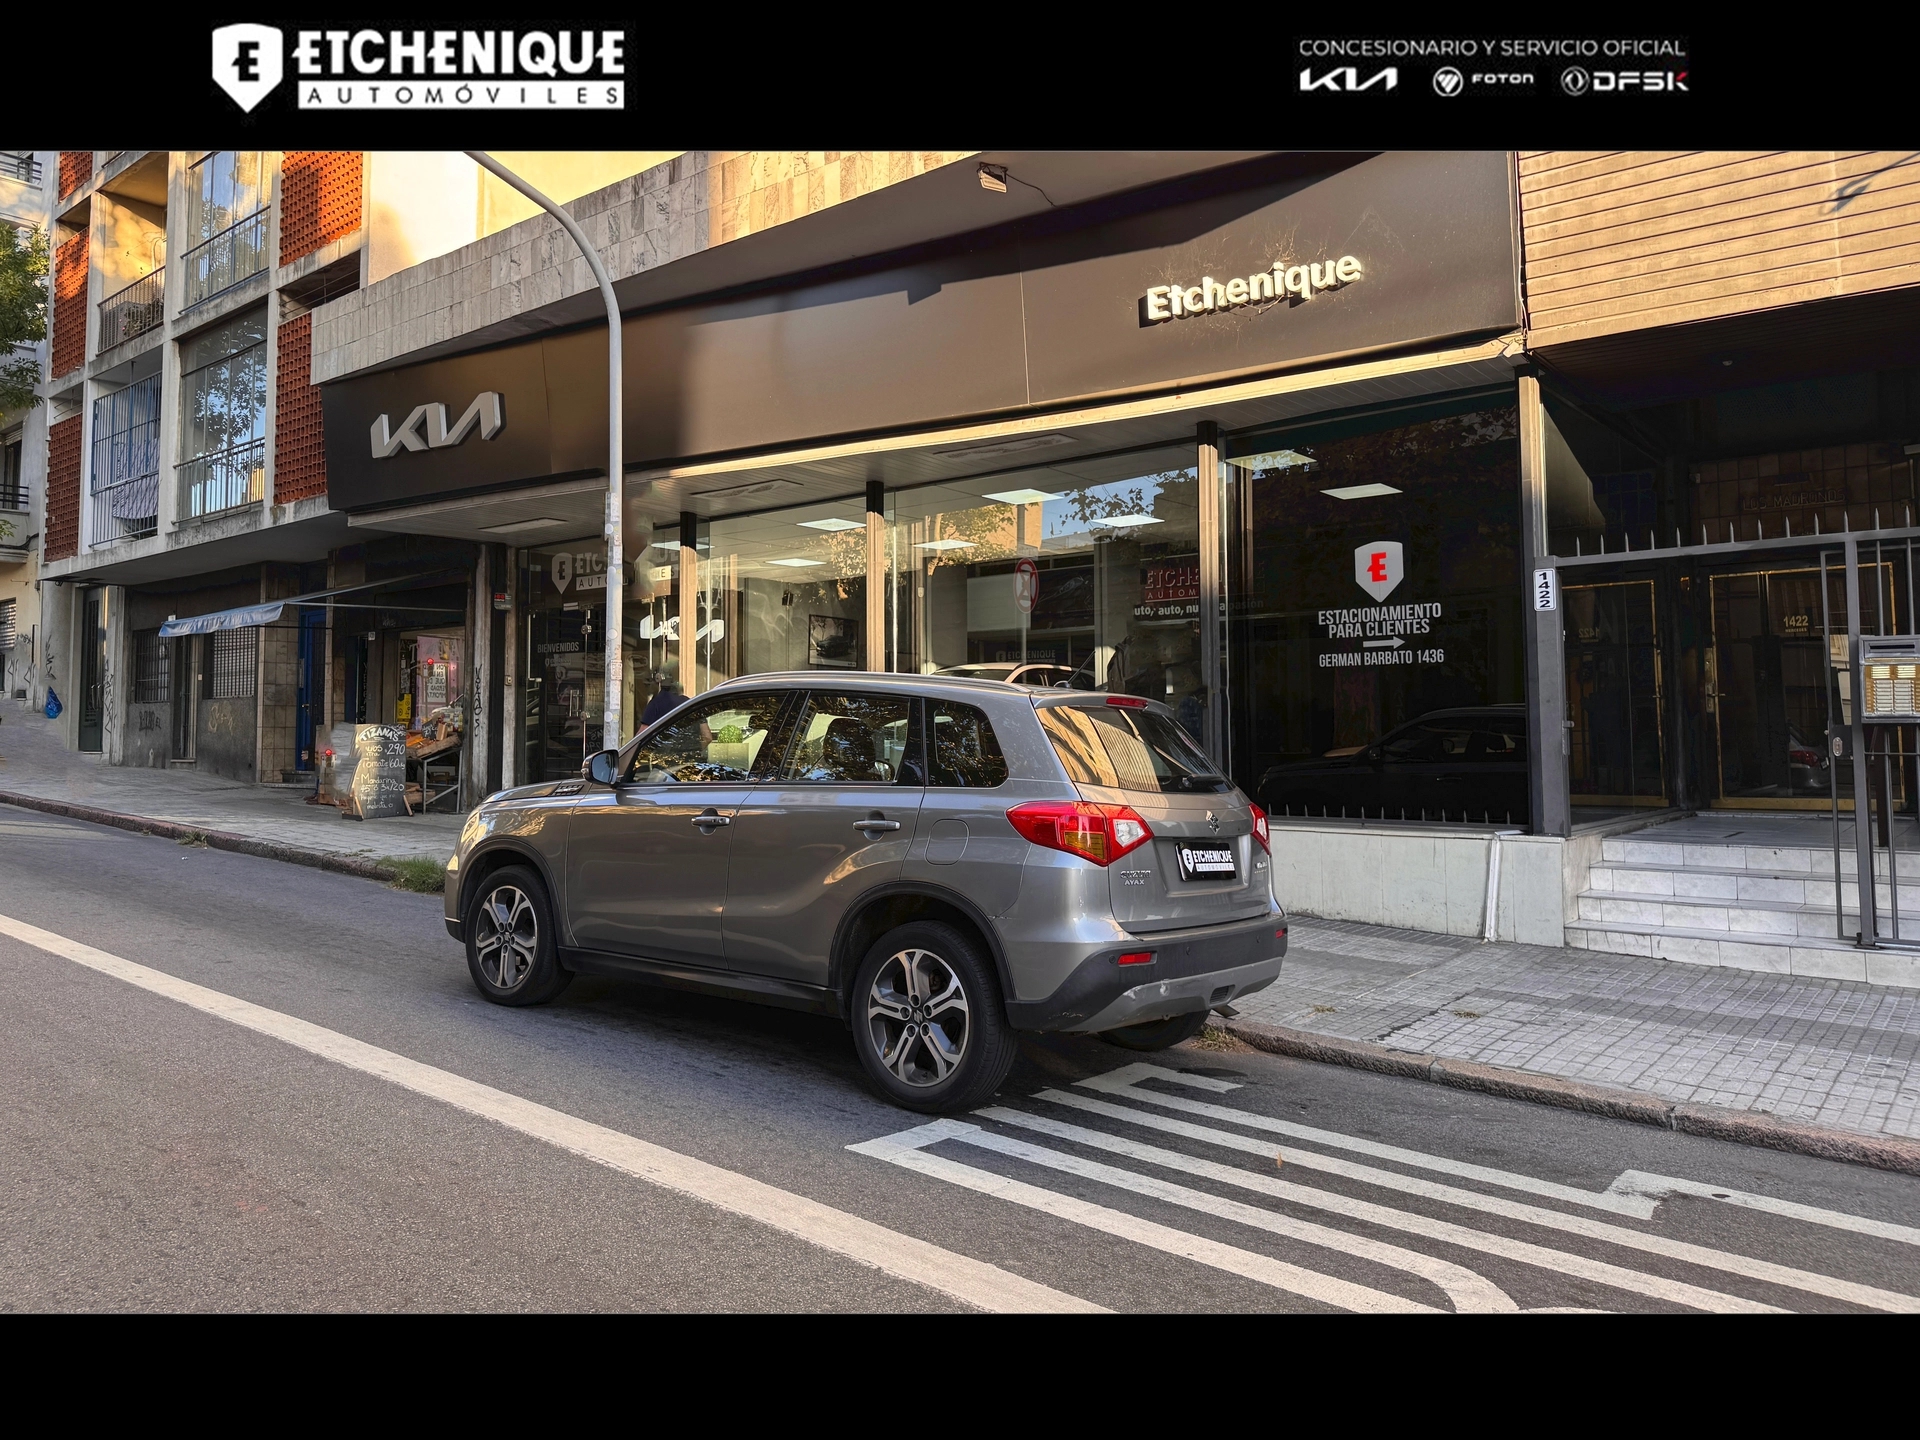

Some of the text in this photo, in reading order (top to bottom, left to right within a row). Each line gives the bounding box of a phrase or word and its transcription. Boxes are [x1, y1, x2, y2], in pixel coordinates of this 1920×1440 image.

[1147, 255, 1362, 320] Etchenique
[370, 391, 501, 459] KIA
[1537, 571, 1551, 608] 1422
[1318, 602, 1442, 625] ESTACIONAMIENTO
[1783, 615, 1809, 628] 1422
[1328, 618, 1430, 639] PARA CLIENTES
[537, 641, 580, 653] BIENVENIDOS
[1007, 650, 1056, 660] ETCENIQUE
[1319, 649, 1445, 668] GERMAN BARBATO 1436
[1192, 850, 1233, 863] ETCHENIQUE
